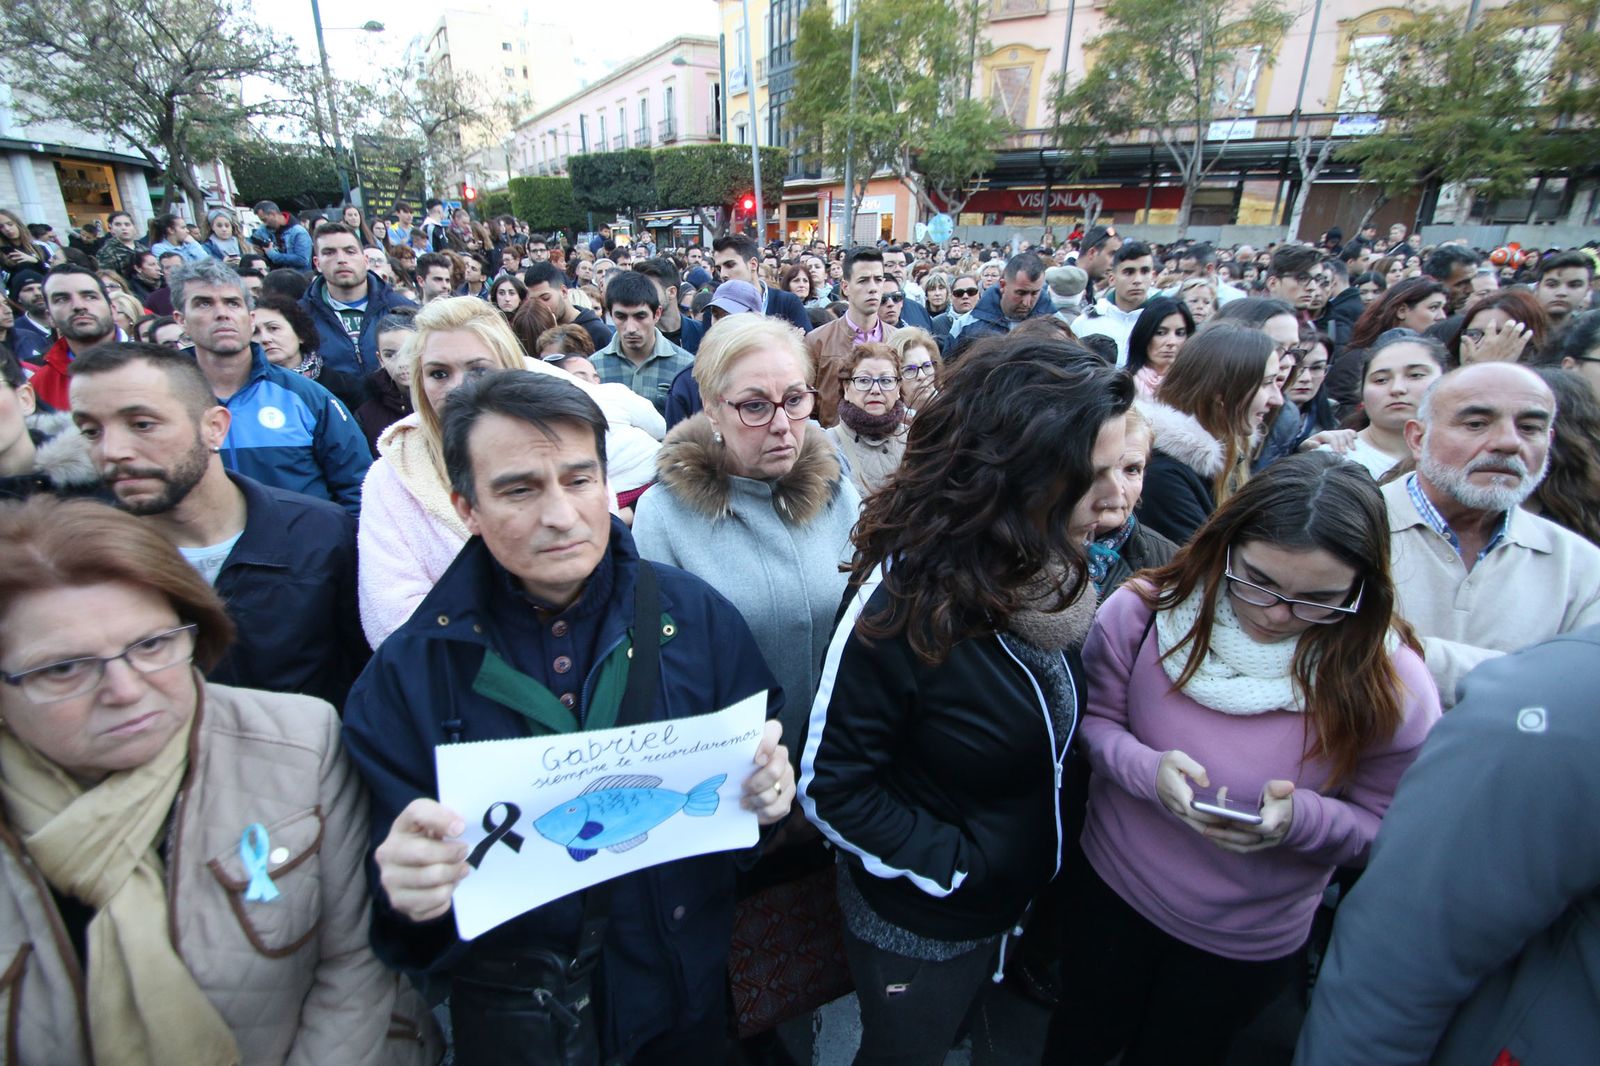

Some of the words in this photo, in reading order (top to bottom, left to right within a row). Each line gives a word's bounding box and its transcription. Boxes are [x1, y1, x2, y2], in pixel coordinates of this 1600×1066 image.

[1017, 192, 1092, 208] VISIONLA
[532, 763, 608, 789] siempre
[616, 756, 632, 767] te
[640, 729, 760, 762] recordaremos
[542, 724, 679, 771] Gabriel
